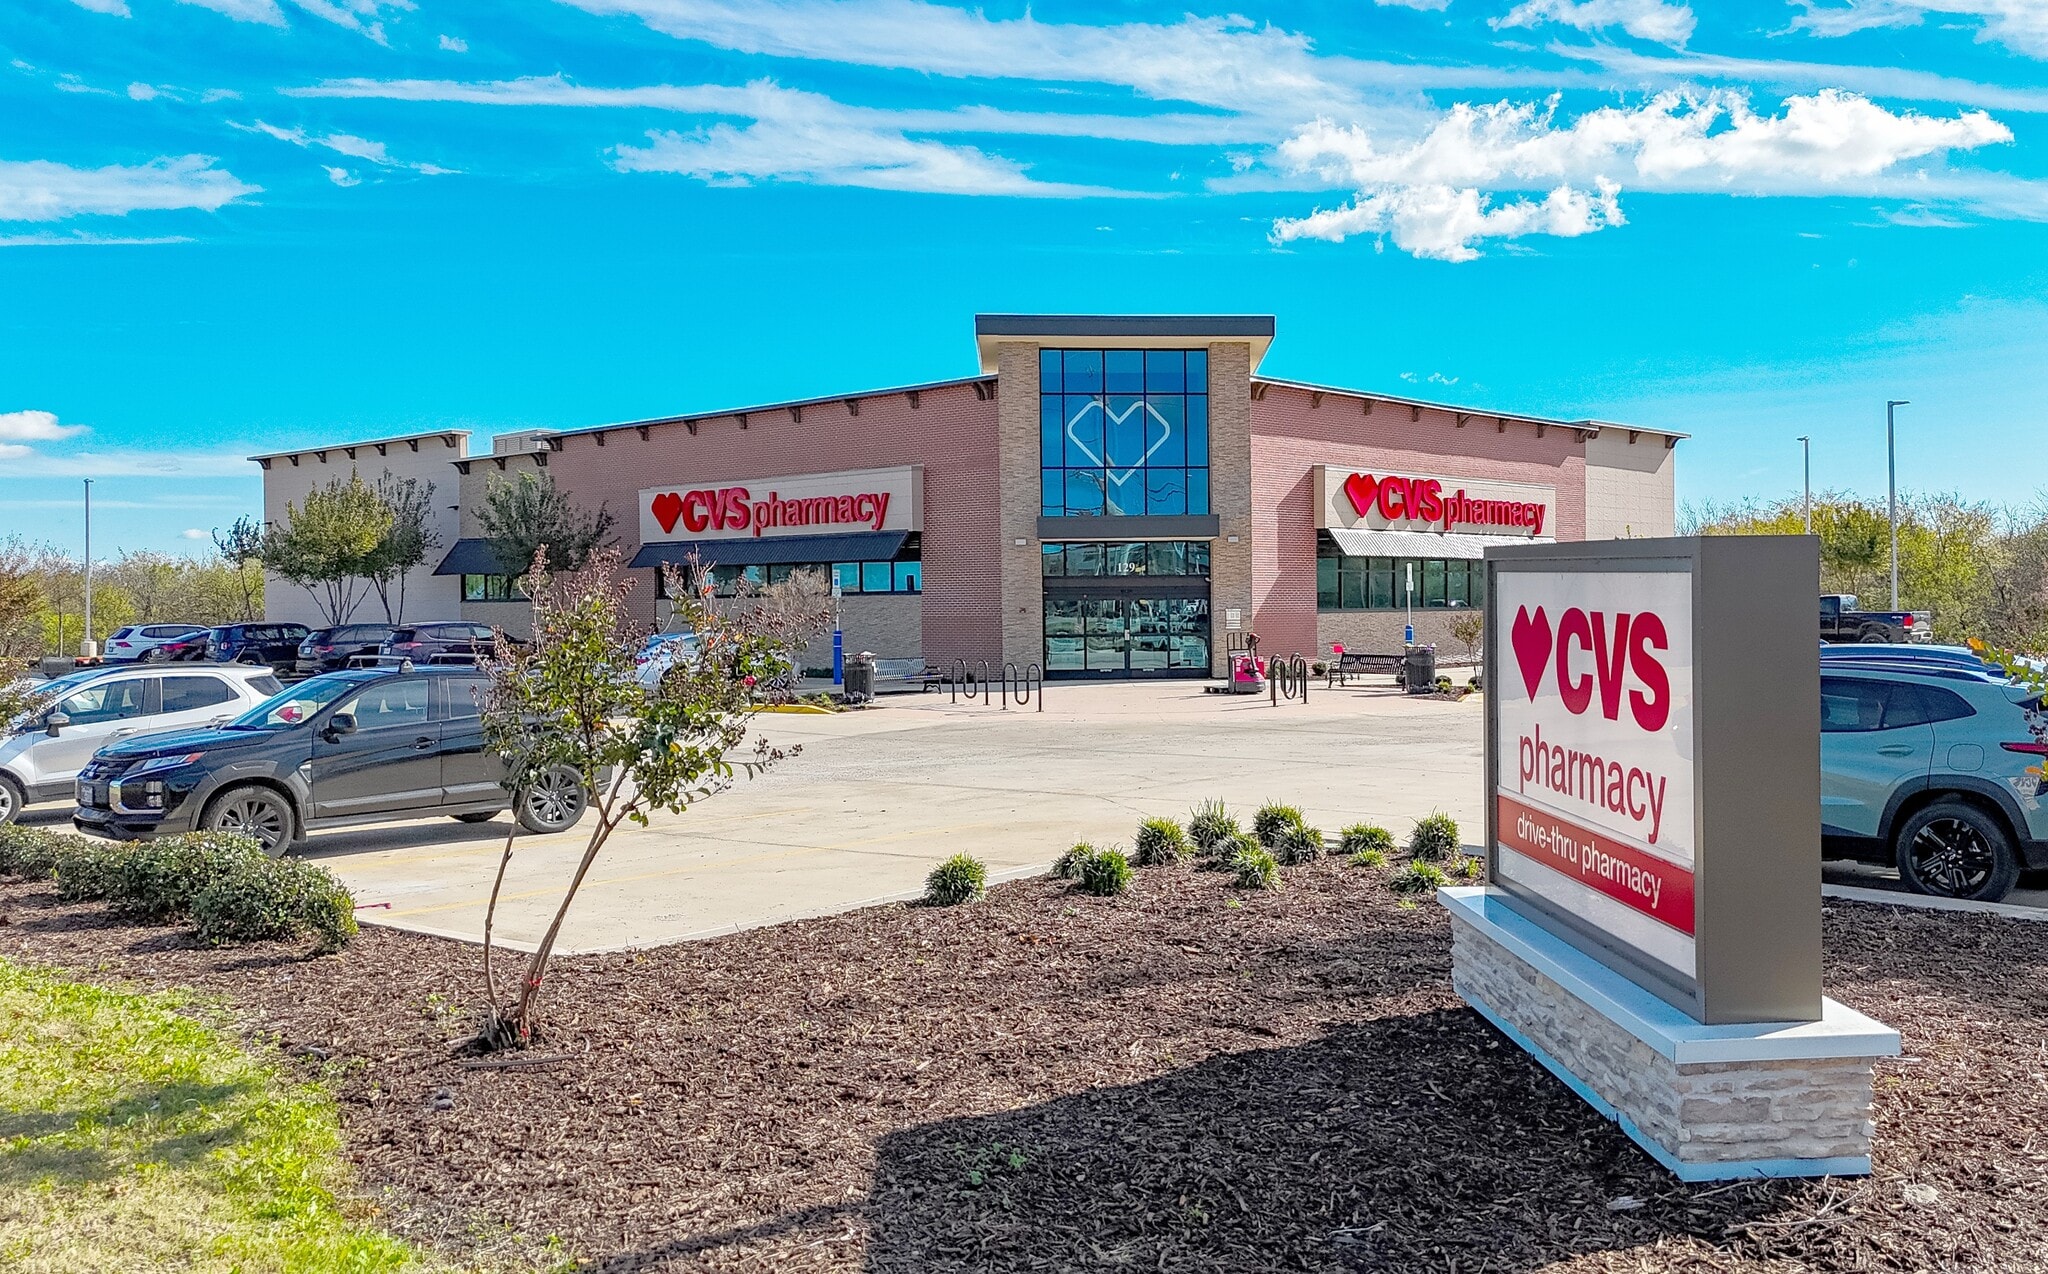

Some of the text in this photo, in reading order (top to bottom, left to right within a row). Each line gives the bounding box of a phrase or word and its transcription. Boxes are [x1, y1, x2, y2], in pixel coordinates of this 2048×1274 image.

[682, 487, 890, 537] CVS pharmacy
[1376, 475, 1546, 535] CVS pharmacy
[1556, 607, 1670, 732] CVS
[1519, 723, 1667, 844] pharmacy
[1517, 811, 1661, 909] drive-thru pharmacy
